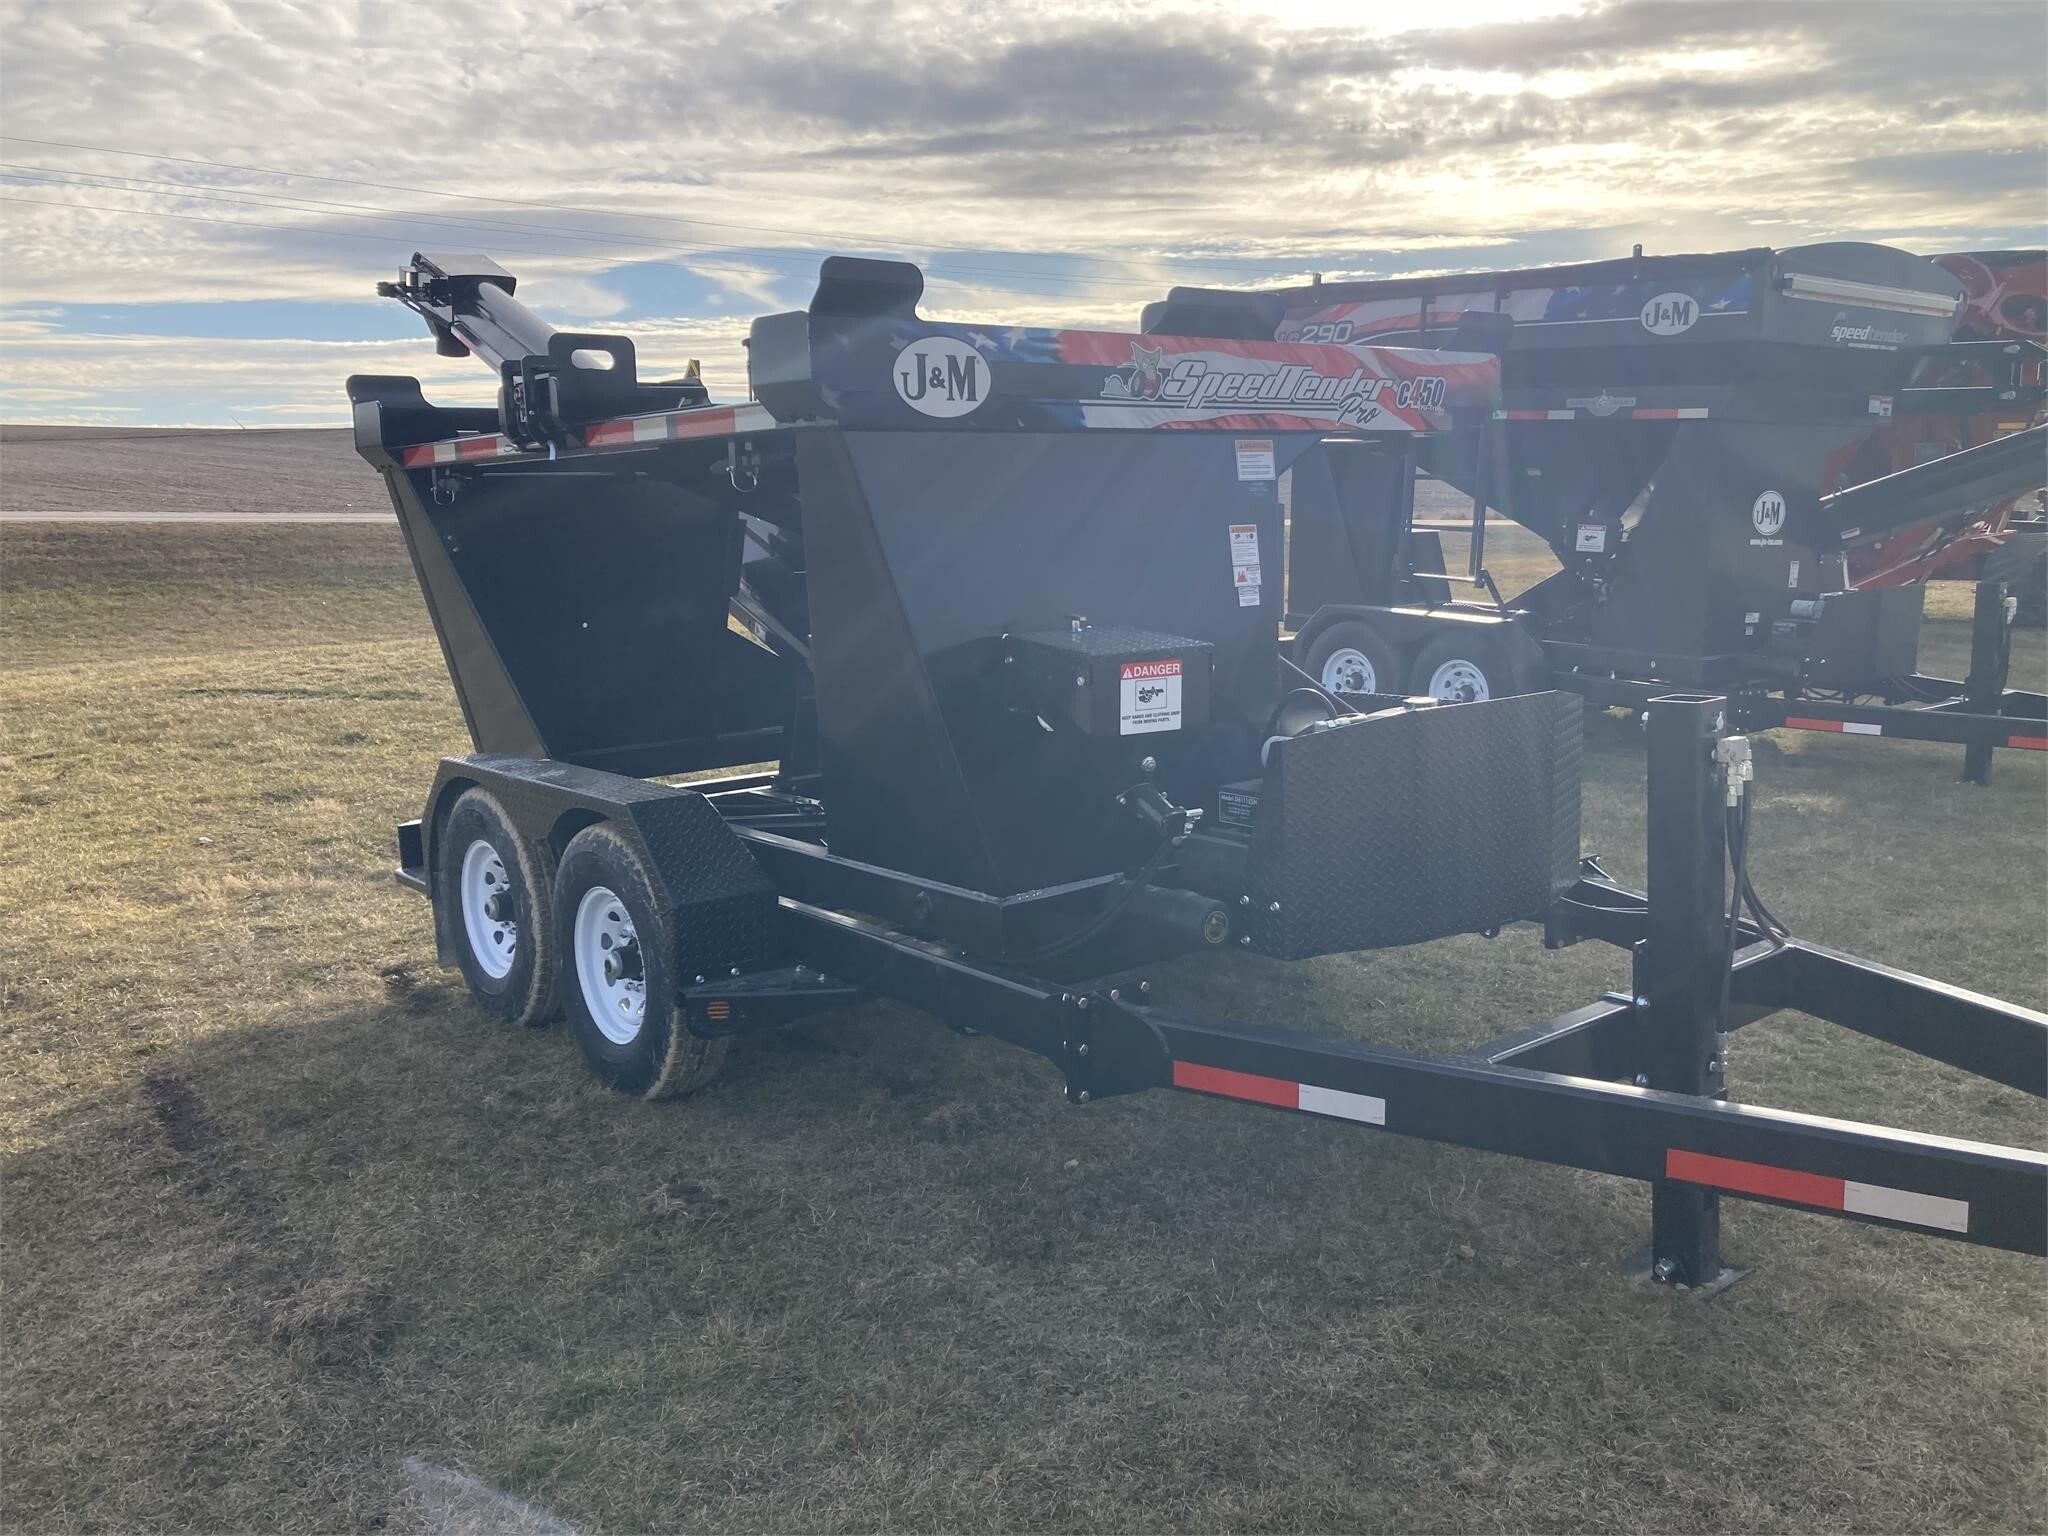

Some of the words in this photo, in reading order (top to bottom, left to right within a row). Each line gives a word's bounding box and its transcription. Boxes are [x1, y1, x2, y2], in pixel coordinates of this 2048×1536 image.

[1645, 301, 1693, 328] J&M
[1831, 326, 1909, 343] speedtender
[900, 353, 978, 402] J&M
[1163, 360, 1393, 409] SpeedTender
[1336, 392, 1382, 425] Pro
[1756, 501, 1781, 525] J&M
[1133, 663, 1181, 677] DANGER
